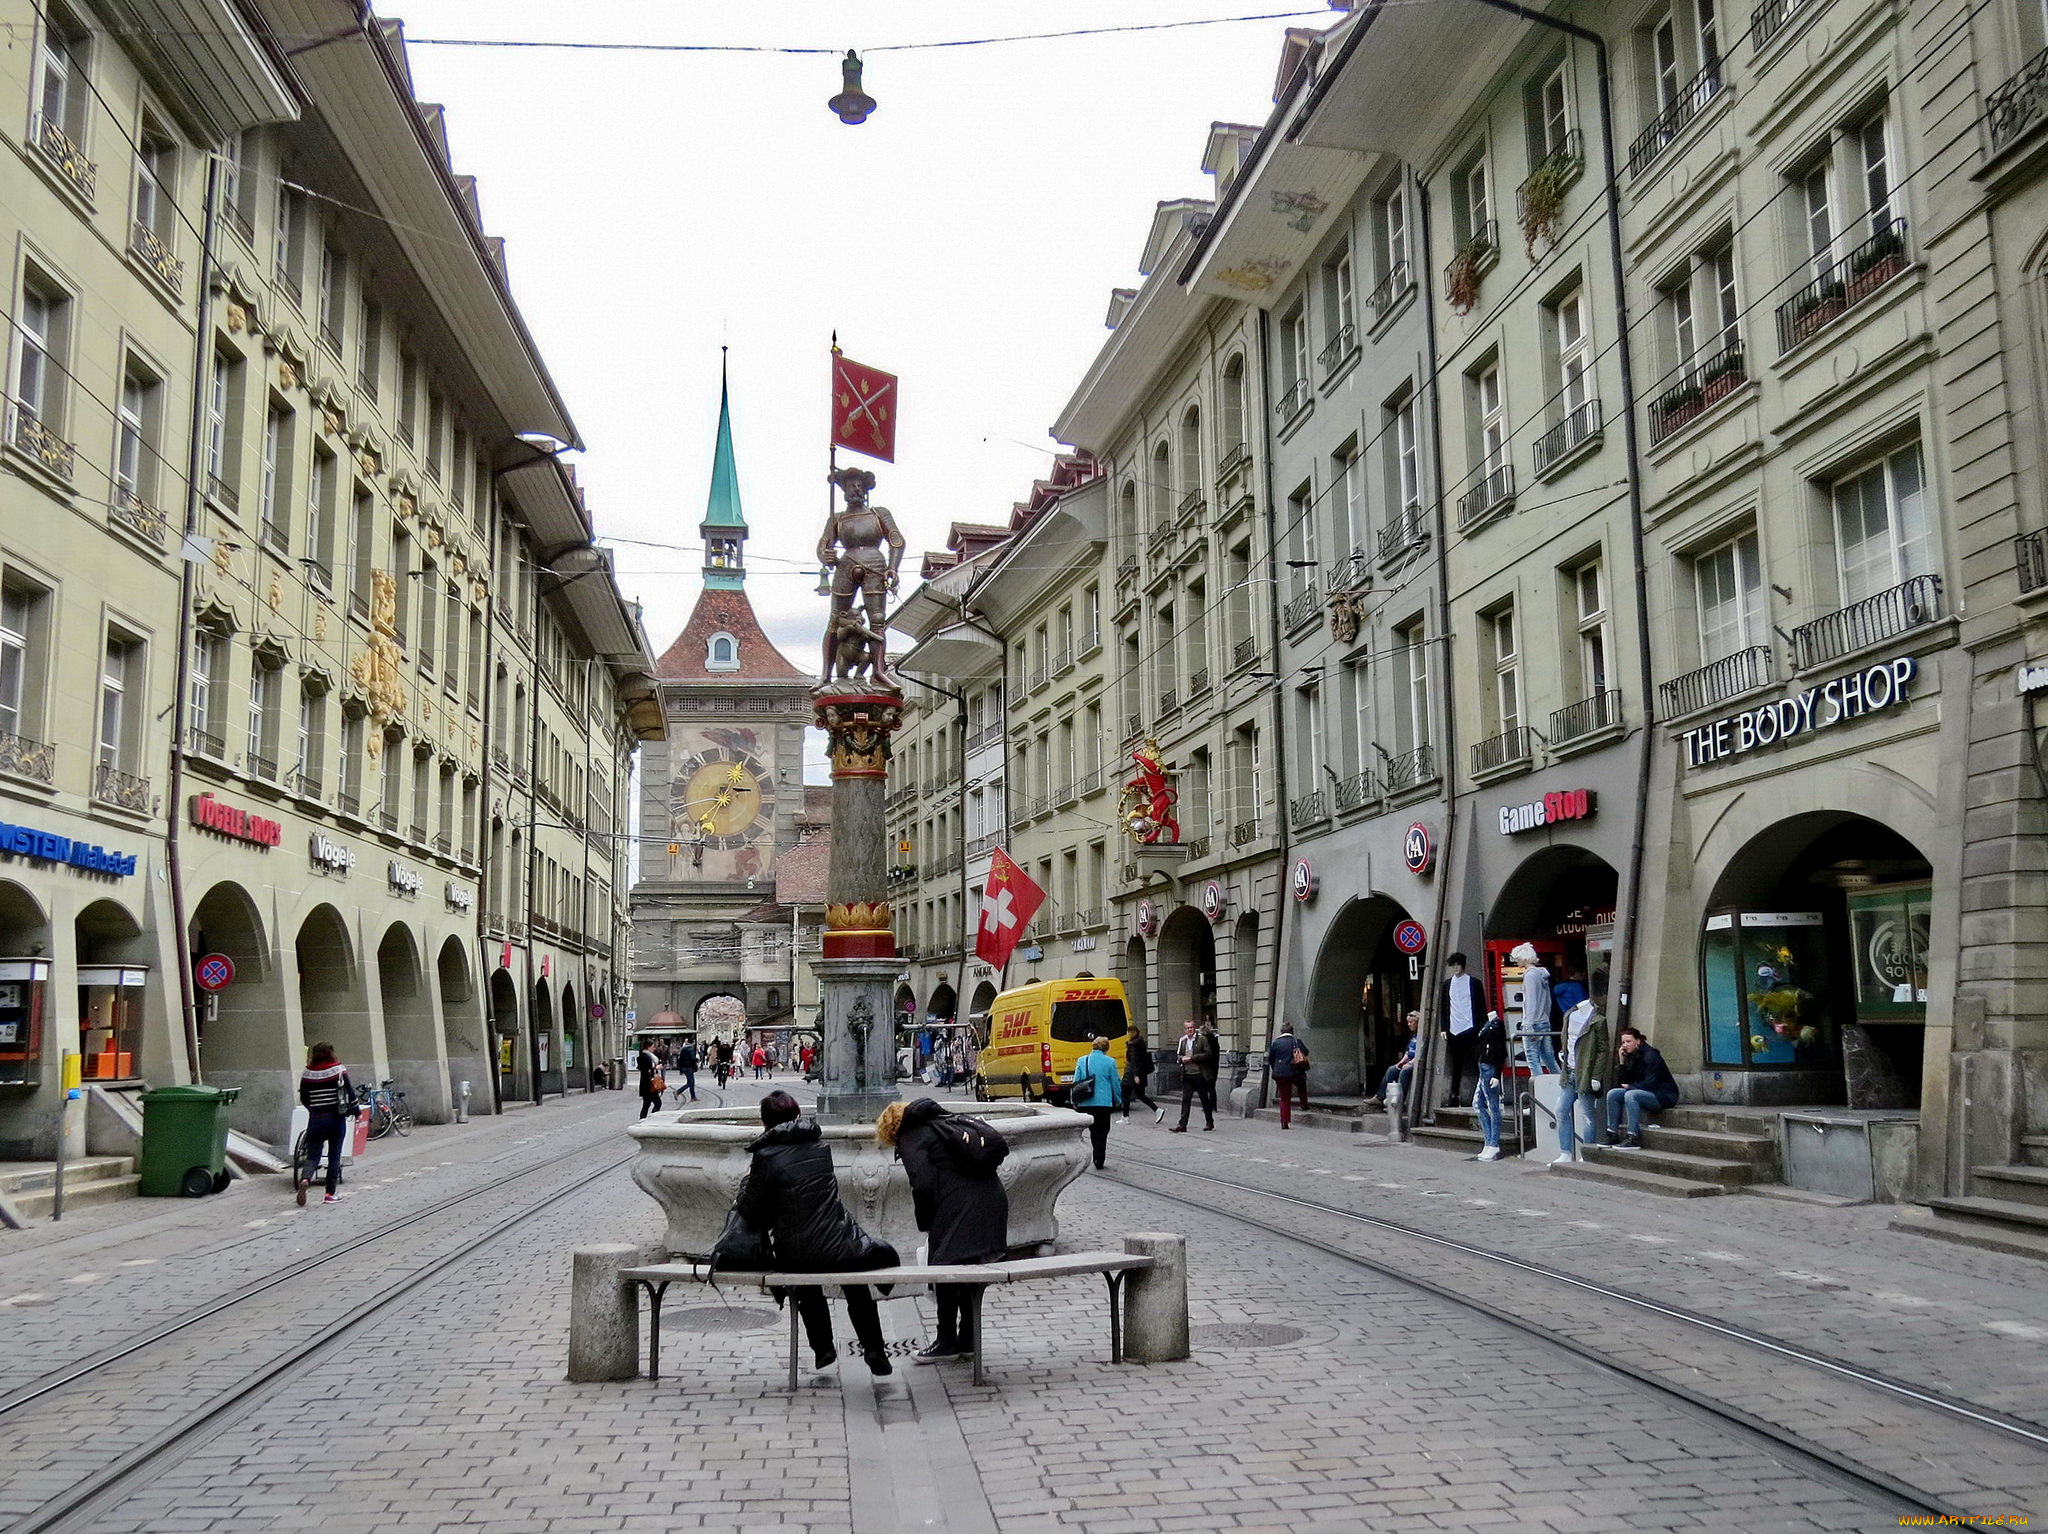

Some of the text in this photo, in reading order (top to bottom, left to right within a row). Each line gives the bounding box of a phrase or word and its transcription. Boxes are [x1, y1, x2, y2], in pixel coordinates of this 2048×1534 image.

[1682, 657, 1914, 766] THE BODY SHOP
[197, 792, 282, 847] VÖGELE SHOES
[1499, 789, 1588, 836] GameStop
[317, 836, 356, 869] Vögele
[1406, 835, 1424, 860] C&A
[394, 862, 424, 890] Vögele
[1295, 869, 1307, 888] C&A
[1064, 989, 1111, 1001] DHL
[1002, 1011, 1034, 1039] DHL
